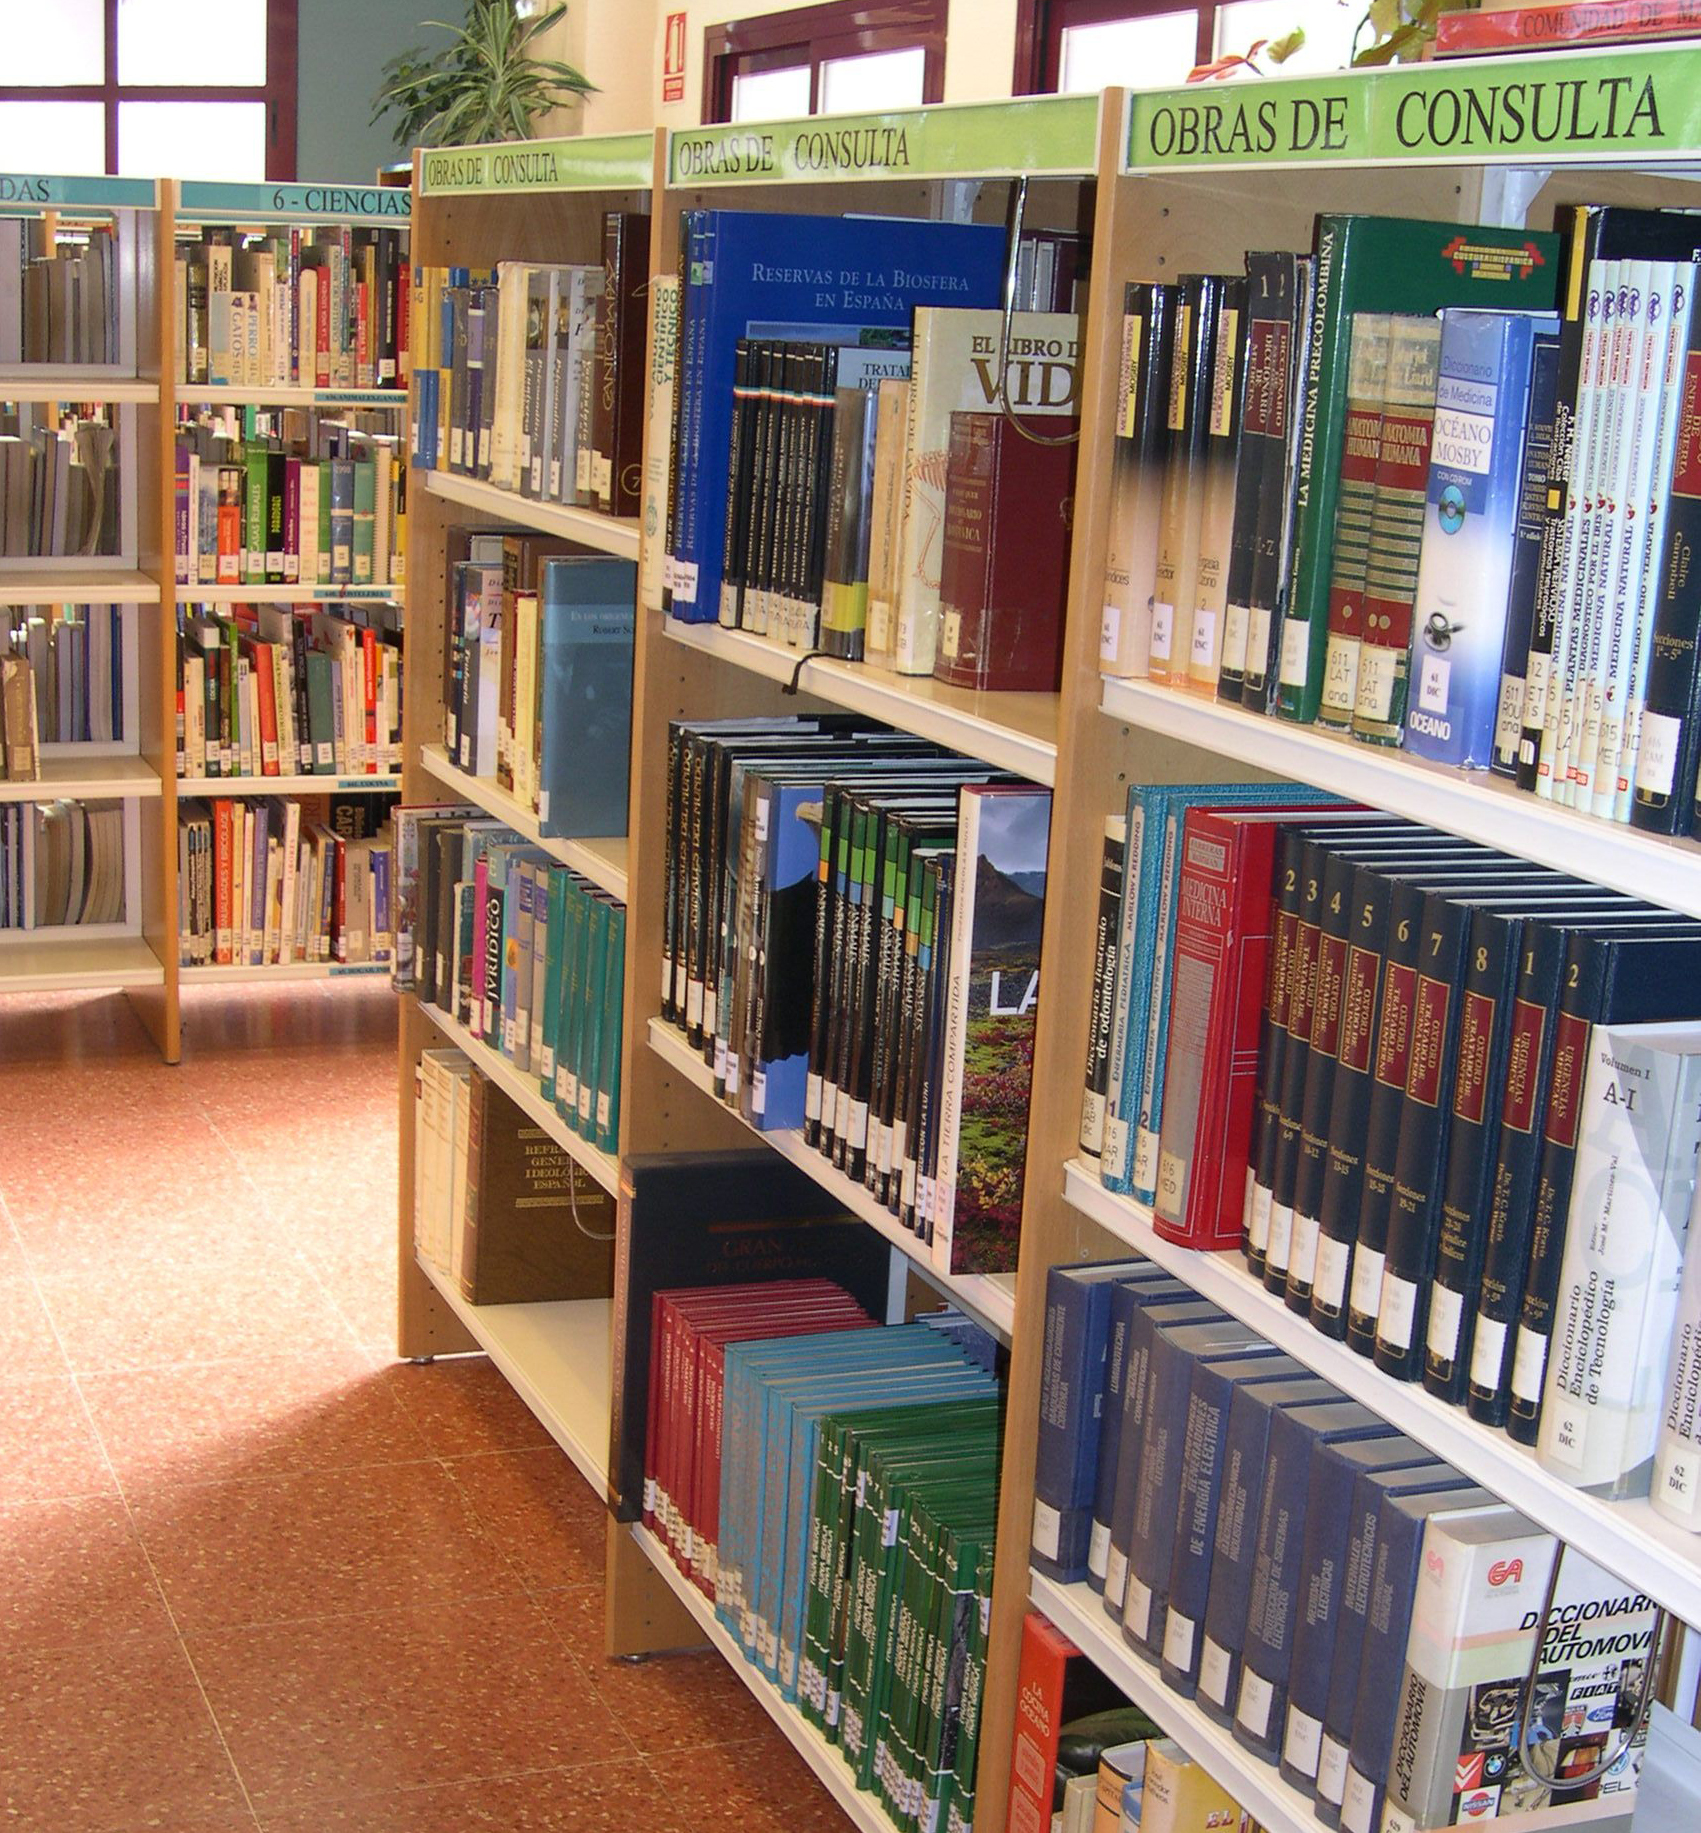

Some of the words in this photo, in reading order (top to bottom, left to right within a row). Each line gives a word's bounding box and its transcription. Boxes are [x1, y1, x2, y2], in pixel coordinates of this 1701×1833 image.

[1522, 7, 1622, 38] COMUNIDAD
[1638, 2, 1662, 27] DE
[1677, 0, 1701, 24] M
[1149, 102, 1278, 157] OBRAS
[1288, 96, 1348, 151] DE
[1397, 74, 1665, 148] CONSULTA
[429, 155, 463, 186] OBRAS
[466, 157, 482, 184] DE
[494, 152, 558, 184] CONSULTA
[679, 141, 741, 176] OBRAS
[746, 136, 773, 172] DE
[795, 129, 910, 170] CONSULTA
[305, 189, 411, 215] CIENCIAS
[752, 262, 833, 285] RESERVAS
[839, 271, 860, 286] DE
[865, 273, 886, 288] LA
[892, 270, 969, 292] BIOSFERA
[815, 293, 836, 308] EN
[843, 290, 905, 311] ESPAÑA
[1309, 231, 1334, 386] PRECOLOMBINA
[971, 336, 995, 354] EL
[1008, 337, 1062, 357] IBRO
[908, 358, 920, 412] LIBRO
[1129, 360, 1138, 395] MOSBY
[1225, 355, 1235, 391] MOSBY
[1247, 344, 1258, 412] MEDICINA
[1259, 334, 1273, 424] DICCIONARIO
[1451, 387, 1492, 407] Medicina
[1301, 388, 1319, 481] MEDICINA
[1435, 412, 1491, 444] OCÉANO
[1435, 443, 1482, 468] MOSBY
[1298, 481, 1311, 507] LA
[1589, 540, 1599, 557] EL
[1587, 559, 1597, 585] POR
[1551, 588, 1566, 664] MEDICINA
[1560, 515, 1574, 584] NATURAL
[1565, 626, 1579, 692] PLANTAS
[1573, 518, 1590, 622] MEDICINALES
[1590, 594, 1606, 672] MEDICINA
[1599, 519, 1614, 590] NATURAL
[1609, 601, 1625, 679] MEDICINA
[1617, 525, 1633, 597] NATURAL
[1579, 588, 1594, 672] DIAGNOSTICO
[1409, 711, 1451, 741] OCEANO
[692, 818, 701, 848] DEL
[1182, 876, 1227, 908] MEDICINA
[1286, 869, 1295, 892] 2
[1306, 880, 1318, 902] 3
[1180, 900, 1222, 928] INTERNA
[1330, 891, 1341, 914] 4
[1361, 904, 1373, 928] 5
[1397, 919, 1409, 943] 6
[1431, 933, 1443, 957] 7
[1112, 1015, 1125, 1084] ENFERMERIA
[1119, 942, 1133, 1012] PEDIATRICA
[1126, 880, 1137, 932] MARLOW
[1132, 821, 1142, 872] REDDING
[1476, 946, 1488, 973] 8
[1524, 951, 1534, 976] 1
[1100, 944, 1118, 1036] odontología
[1568, 963, 1579, 988] 2
[1087, 986, 1101, 1077] Diccionario
[1096, 915, 1108, 984] Ilustrado
[1358, 987, 1371, 1037] OXFORD
[948, 973, 962, 1085] COMPARTIDA
[1397, 1003, 1409, 1053] OXFORD
[1098, 1039, 1107, 1060] de
[1472, 1034, 1486, 1086] OXFORD
[1601, 1052, 1641, 1079] Volumen
[1513, 1030, 1531, 1106] URGENCIAS
[1557, 1045, 1575, 1120] URGENCIAS
[1603, 1081, 1637, 1111] A-I
[941, 1091, 954, 1147] TIERRA
[943, 1154, 950, 1176] LA
[1556, 1283, 1582, 1391] Diccionario
[1568, 1269, 1599, 1399] Enciclopédico
[1589, 1278, 1616, 1382] Tecnología
[1111, 1320, 1126, 1394] LUMINOTECNIA
[1666, 1322, 1692, 1432] Diccionario
[1584, 1383, 1598, 1406] de
[1199, 1405, 1220, 1475] ELECTRICA
[1557, 1434, 1577, 1449] DIC
[1563, 1420, 1574, 1433] 62
[1668, 1477, 1688, 1494] DIC
[1674, 1465, 1686, 1478] 62
[1193, 1479, 1212, 1535] ENERGIA
[1190, 1539, 1205, 1556] DE
[1022, 1686, 1050, 1722] COCINA
[1032, 1682, 1043, 1699] LA
[1571, 1683, 1619, 1700] FIAT
[1020, 1699, 1050, 1738] OCEANO
[1396, 1673, 1419, 1778] DICCIONARIO
[1400, 1775, 1410, 1803] DEL
[1405, 1681, 1427, 1774] AUTOMOVIL
[1205, 1809, 1235, 1830] EL
[1462, 1796, 1495, 1812] NISSAN
